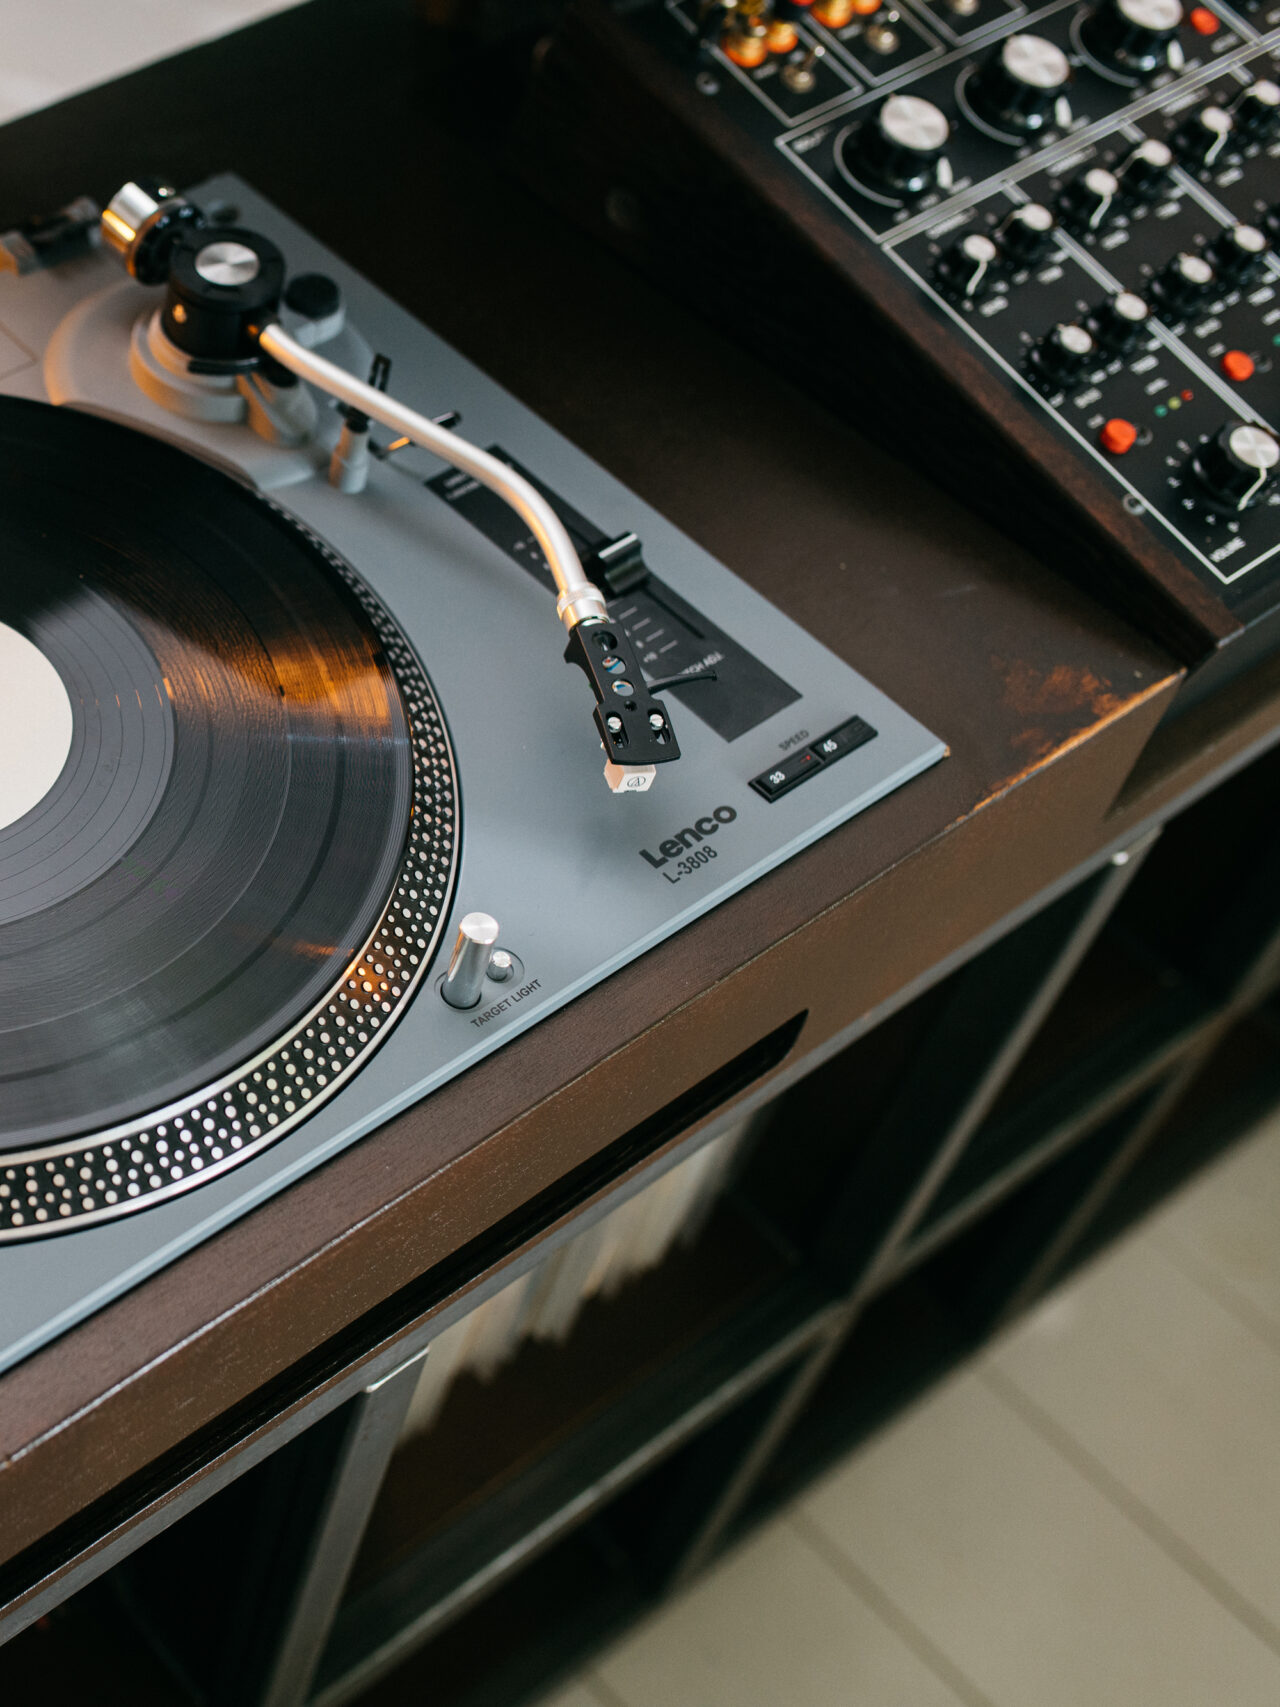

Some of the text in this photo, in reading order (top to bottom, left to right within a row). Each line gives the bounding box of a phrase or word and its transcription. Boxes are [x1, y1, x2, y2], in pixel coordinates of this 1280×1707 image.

[778, 729, 810, 750] SPEED
[823, 739, 837, 752] 45
[770, 771, 785, 784] 33
[638, 805, 737, 869] Lenco
[662, 845, 718, 884] L-3808
[470, 979, 542, 1028] TARGET LIGHT
